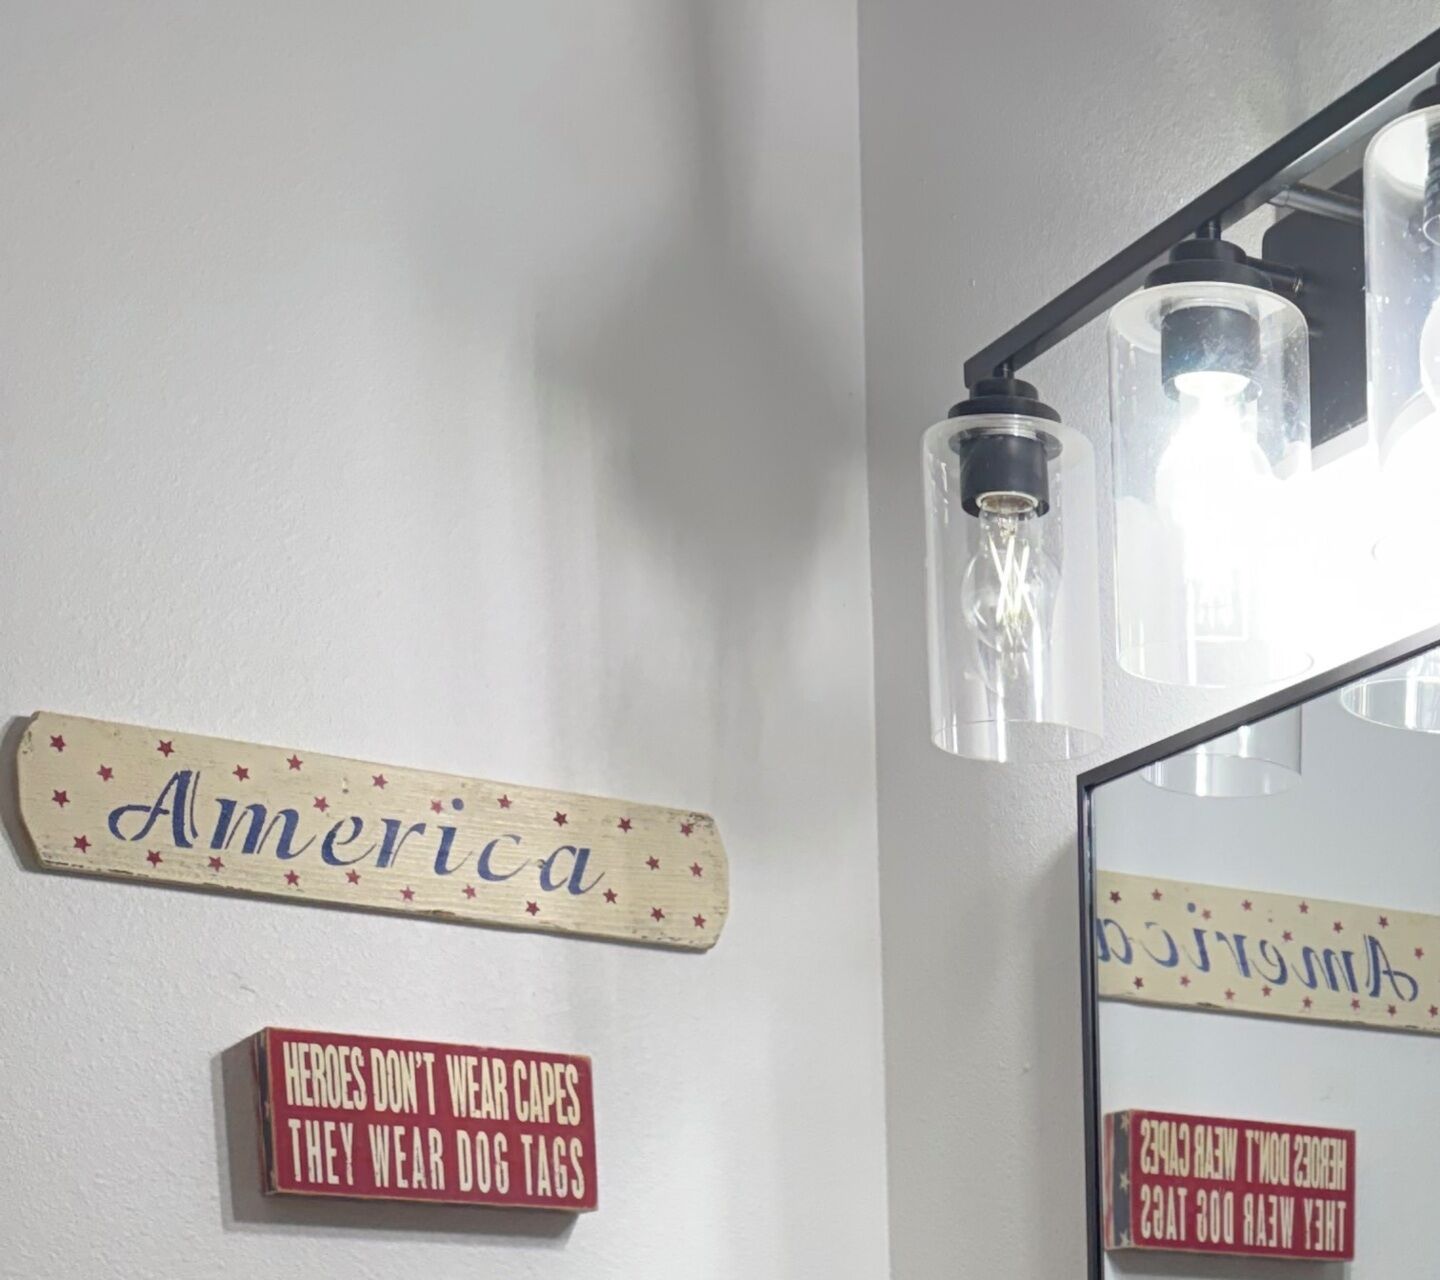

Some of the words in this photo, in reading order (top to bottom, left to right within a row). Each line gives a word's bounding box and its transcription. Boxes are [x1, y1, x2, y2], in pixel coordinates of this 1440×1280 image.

[108, 770, 605, 895] America
[283, 1041, 366, 1112] HEROES
[372, 1049, 436, 1117] DON'T
[447, 1055, 508, 1122] WEAR
[513, 1062, 580, 1127] CAPES
[288, 1120, 355, 1187] THEY
[369, 1127, 446, 1191] WEAR
[458, 1131, 509, 1195] DOG
[523, 1135, 586, 1199] TAGS
